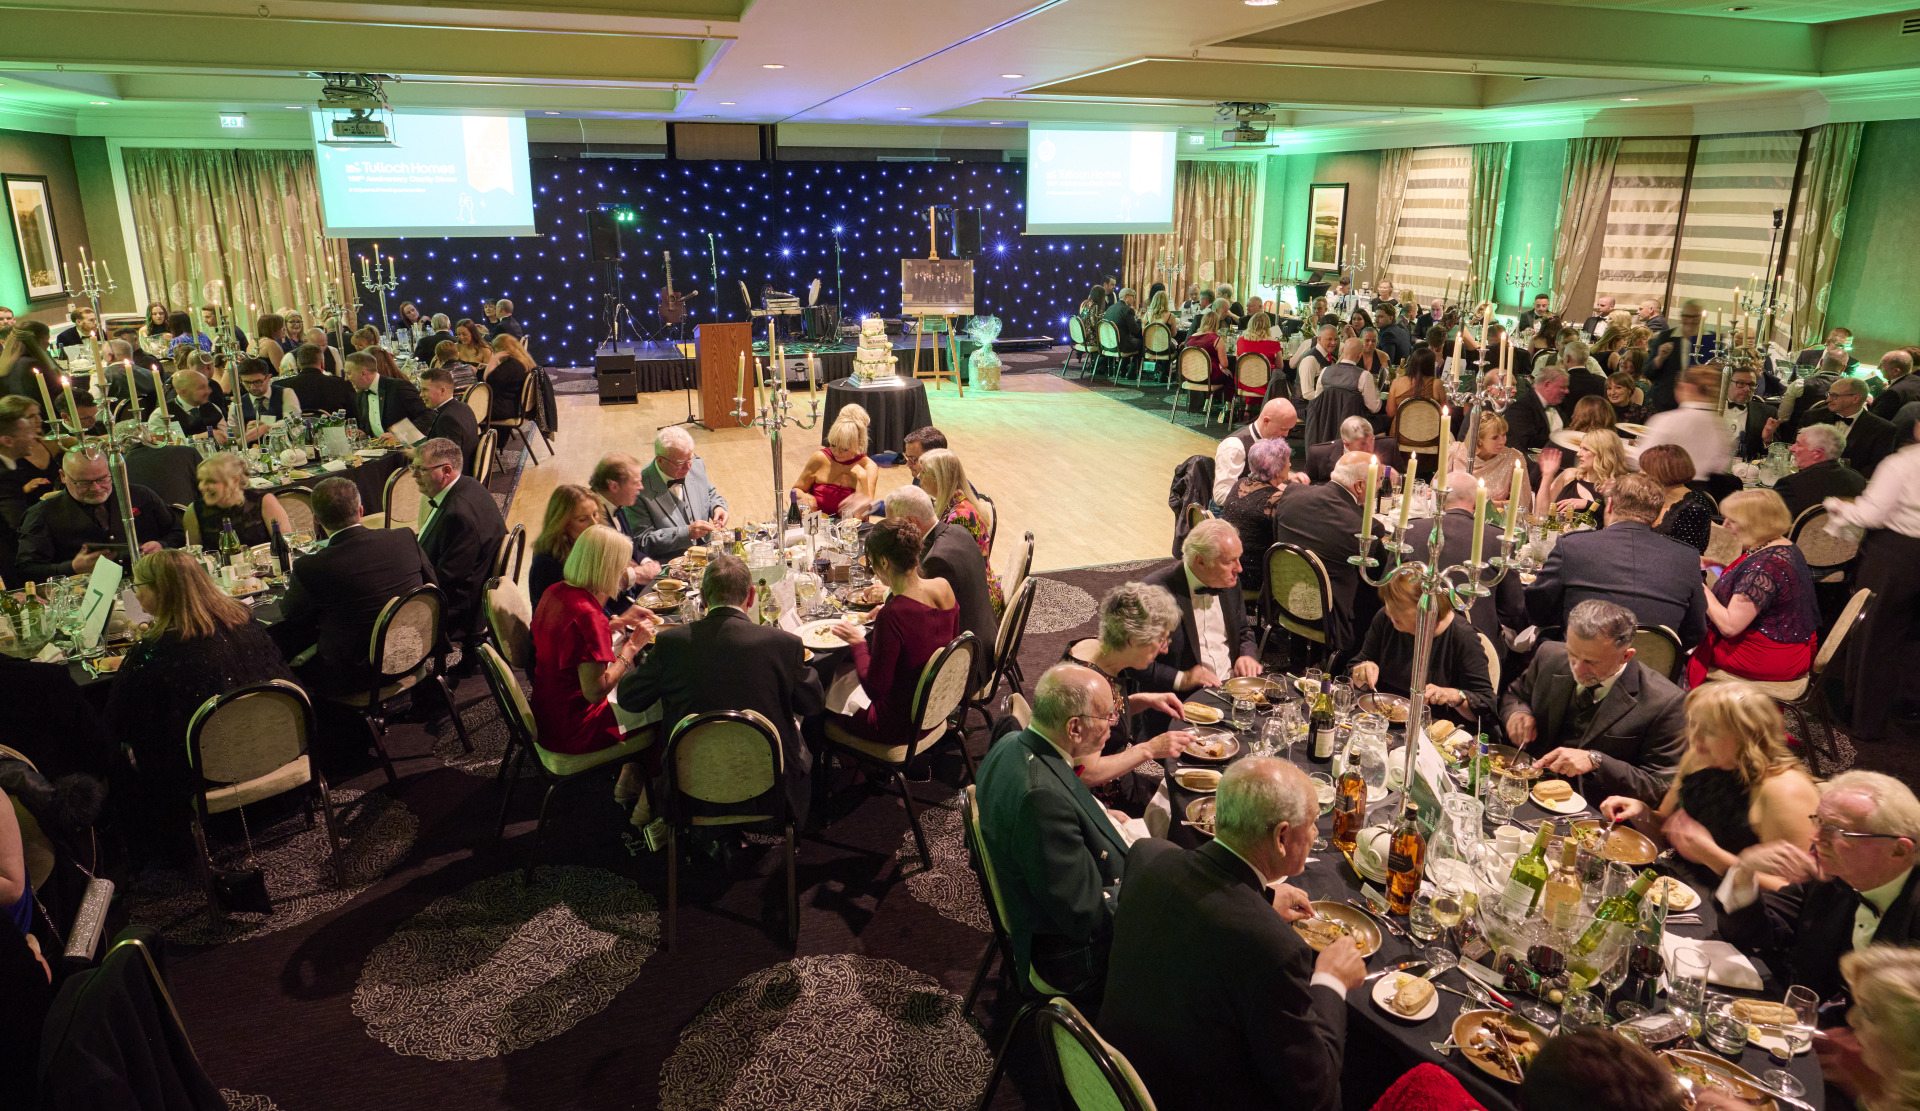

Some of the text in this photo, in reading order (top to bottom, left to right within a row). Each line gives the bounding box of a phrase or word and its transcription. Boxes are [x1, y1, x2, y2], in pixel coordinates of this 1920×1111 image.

[361, 161, 456, 174] Tulloch Homes
[808, 515, 819, 534] 11
[86, 589, 103, 621] 7
